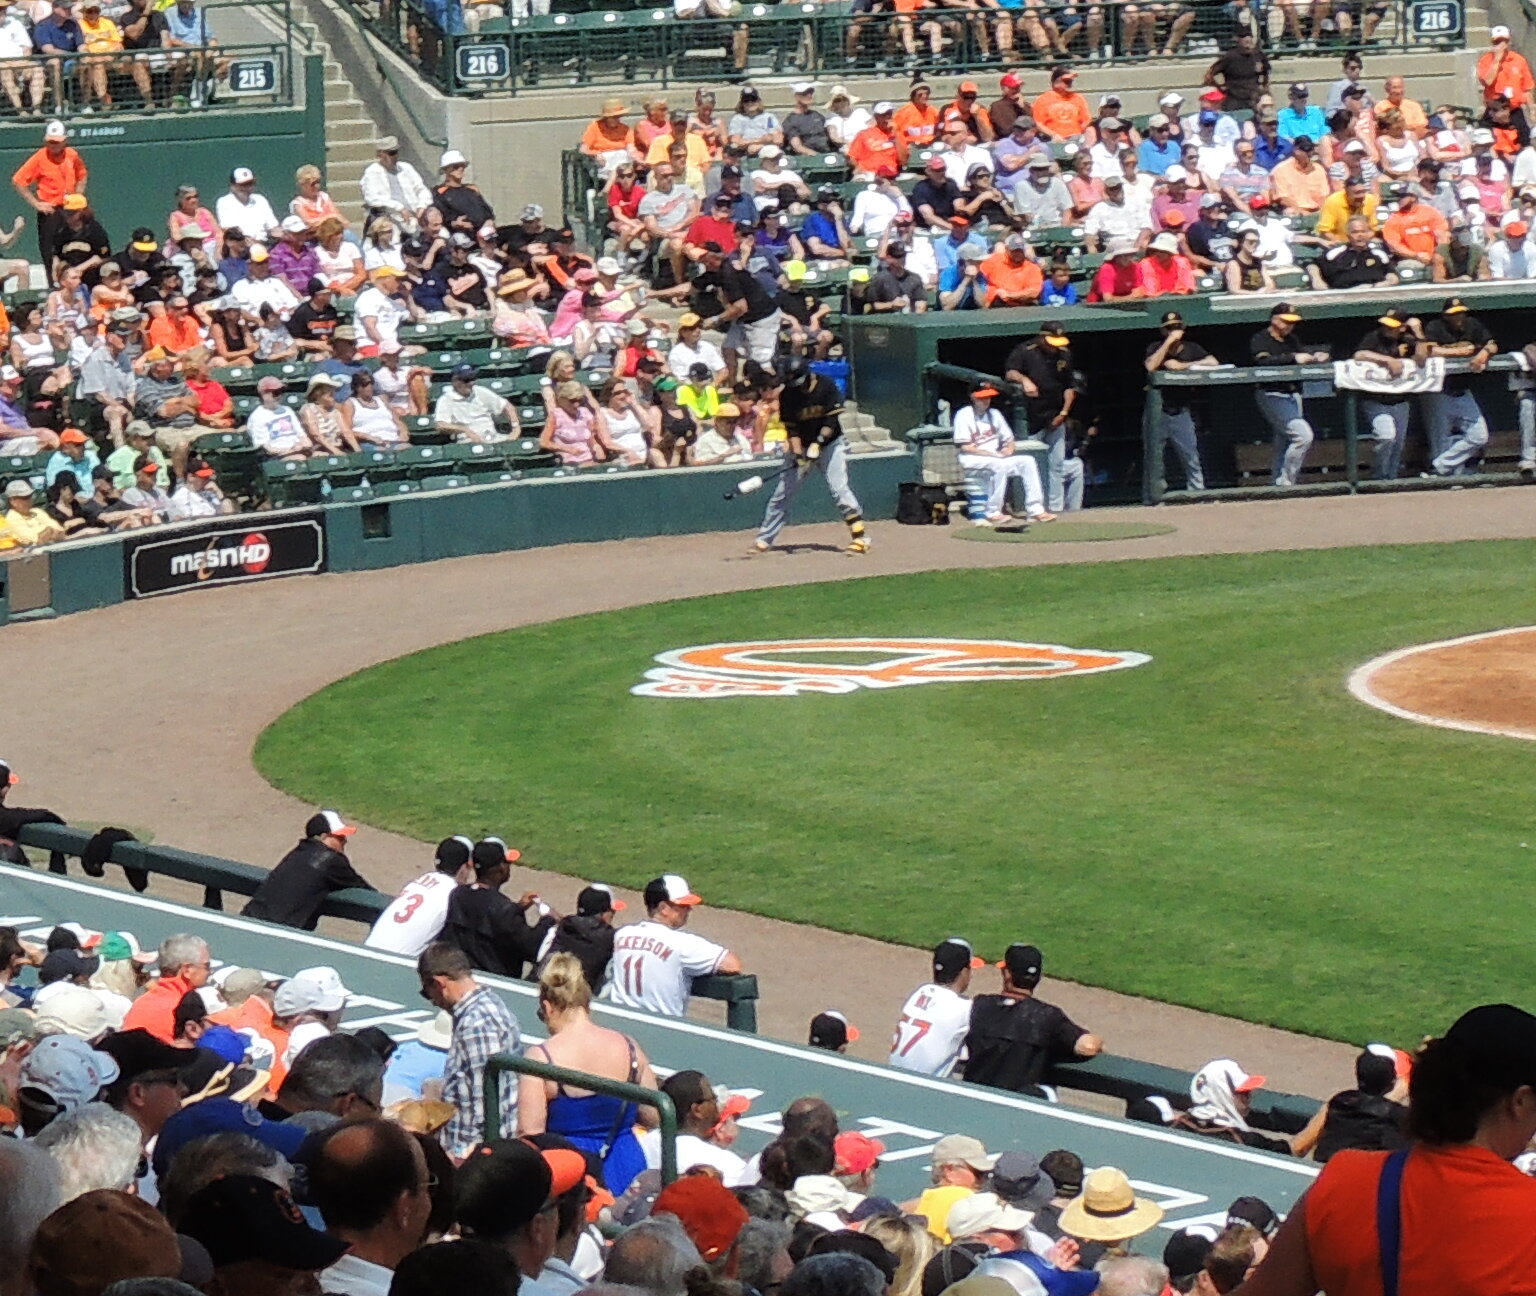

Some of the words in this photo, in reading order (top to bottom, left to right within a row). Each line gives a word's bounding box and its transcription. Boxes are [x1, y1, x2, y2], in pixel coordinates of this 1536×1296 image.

[1420, 10, 1450, 30] 216
[468, 54, 499, 74] 216
[238, 69, 266, 88] 215
[623, 954, 644, 998] 11
